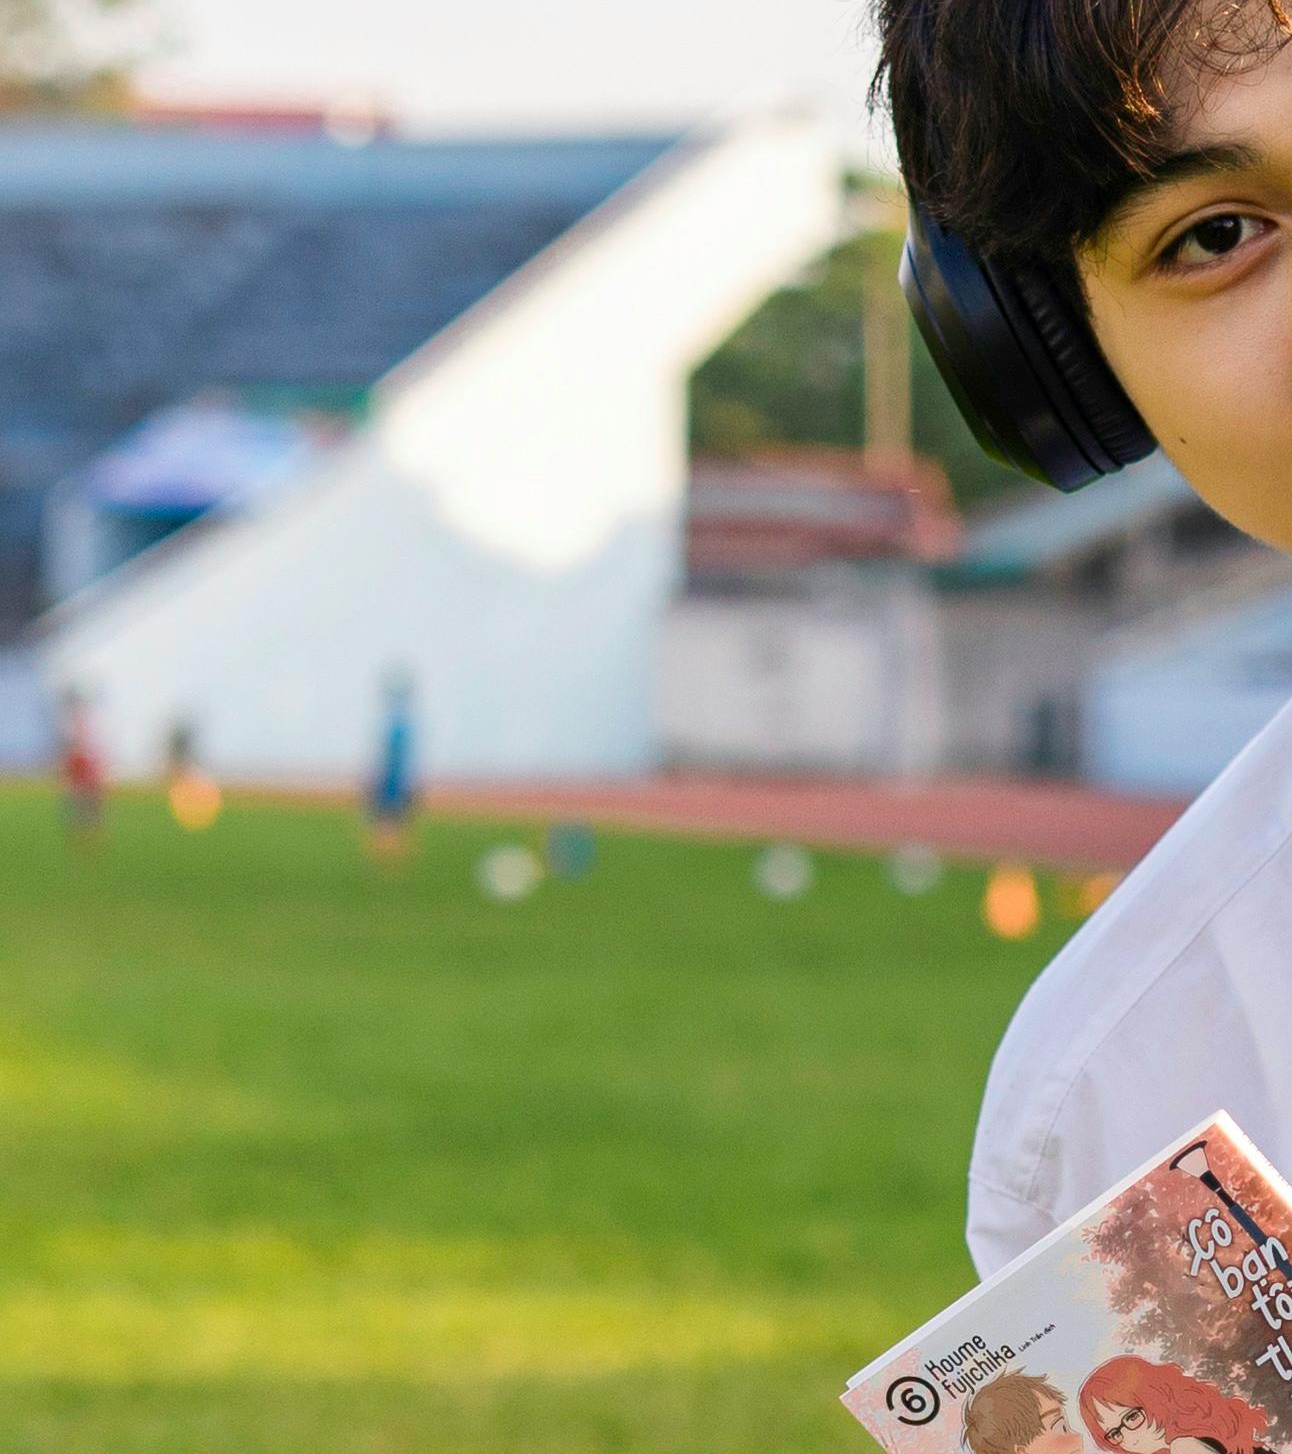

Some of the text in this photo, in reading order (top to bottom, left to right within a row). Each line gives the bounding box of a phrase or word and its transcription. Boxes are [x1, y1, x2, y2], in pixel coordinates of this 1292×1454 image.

[1188, 1208, 1232, 1277] Cô
[1209, 1236, 1289, 1299] bạn
[924, 1334, 987, 1382] Koume
[940, 1344, 1017, 1400] Fujichika
